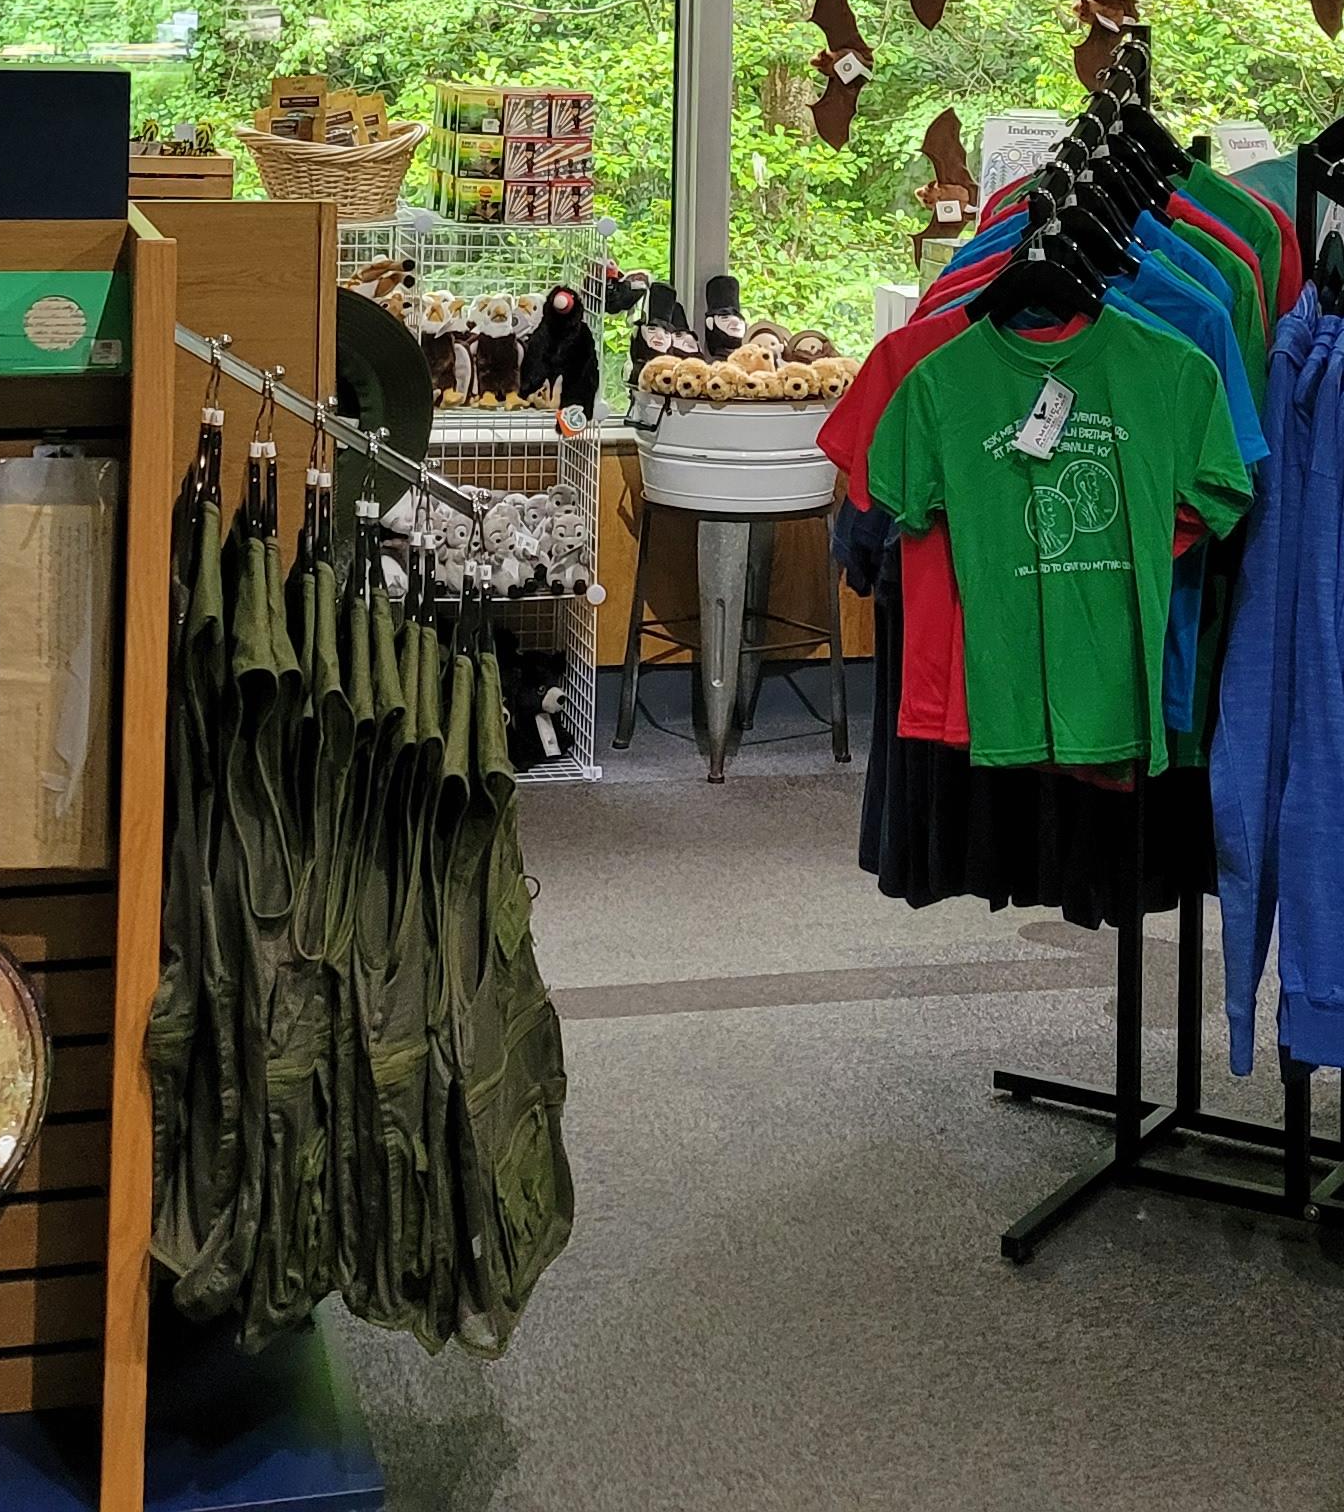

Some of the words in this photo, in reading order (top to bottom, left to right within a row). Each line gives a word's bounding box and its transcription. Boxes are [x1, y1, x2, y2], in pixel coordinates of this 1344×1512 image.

[1007, 125, 1058, 139] Indoorsy
[982, 431, 1002, 452] ASK
[1000, 423, 1016, 439] ME
